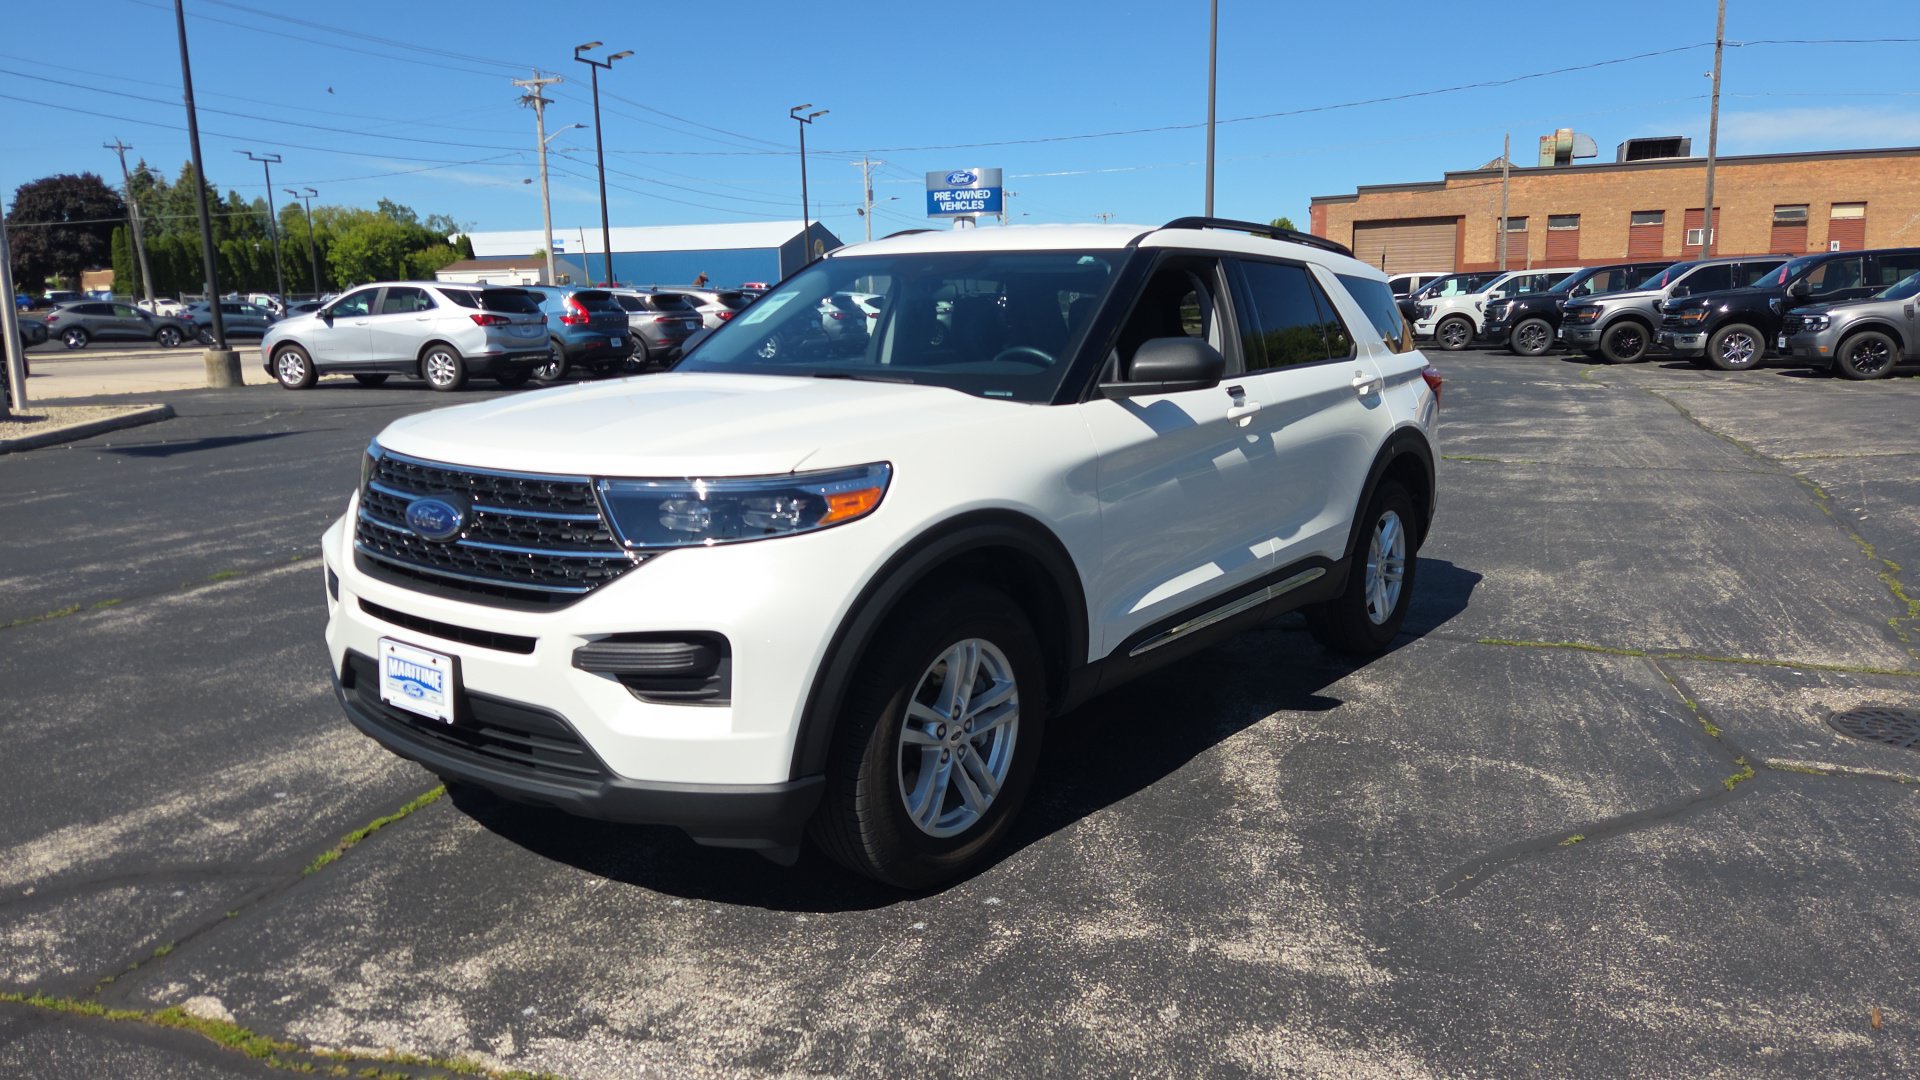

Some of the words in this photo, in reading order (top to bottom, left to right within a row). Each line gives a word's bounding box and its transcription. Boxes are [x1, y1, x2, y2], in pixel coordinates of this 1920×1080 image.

[951, 173, 970, 184] Ford
[940, 200, 985, 211] VEHICLES
[414, 507, 445, 530] Ford
[388, 657, 441, 692] MARITIME
